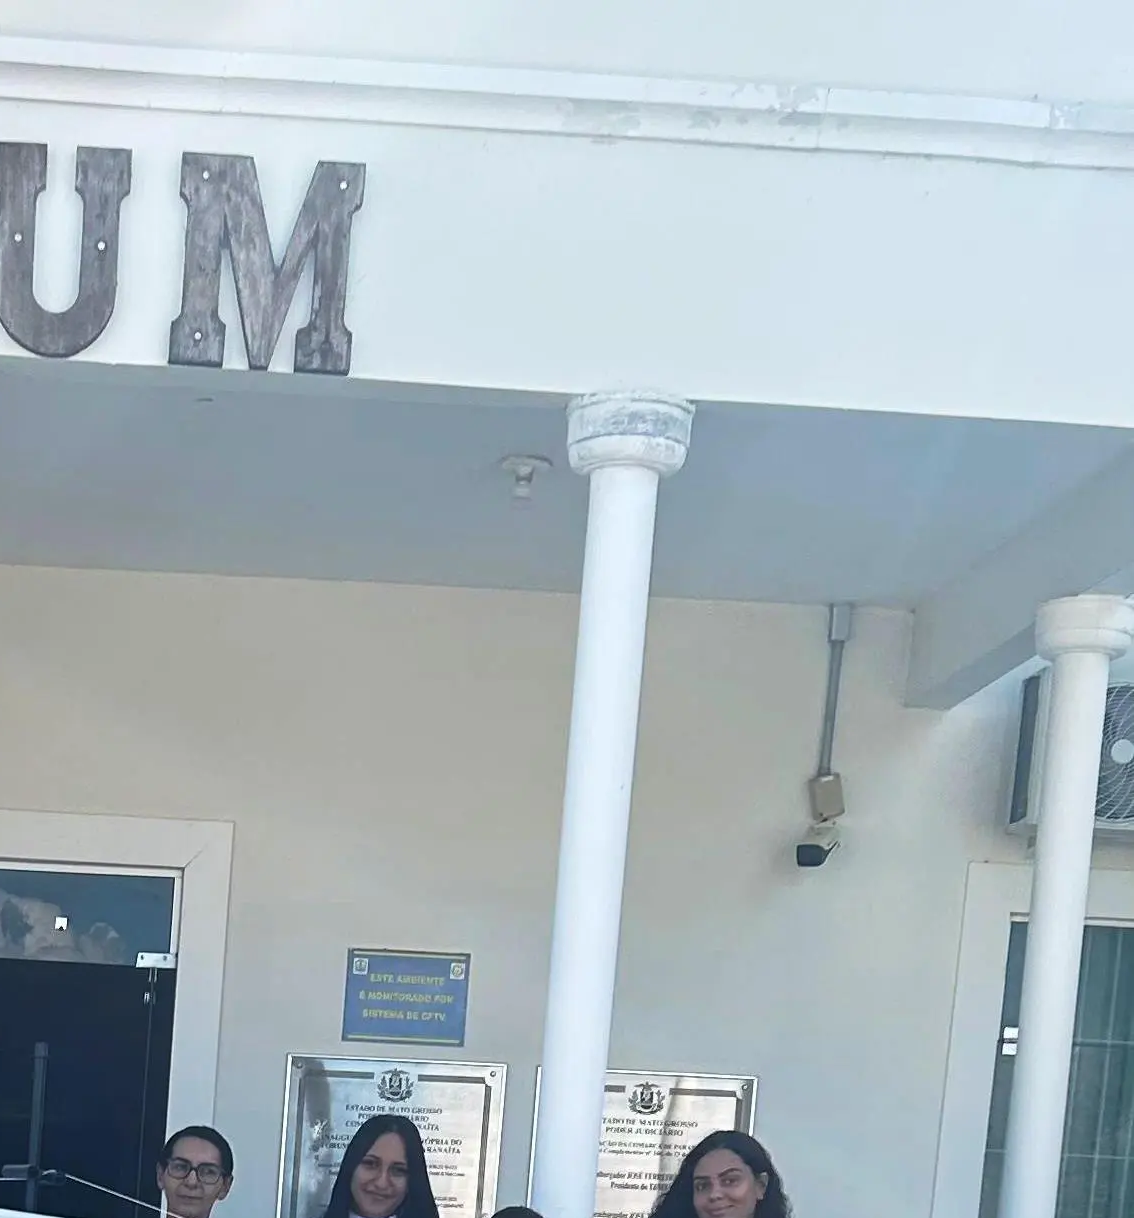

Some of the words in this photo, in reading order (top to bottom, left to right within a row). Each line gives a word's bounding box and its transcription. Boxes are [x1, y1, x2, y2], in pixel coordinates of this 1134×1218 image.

[370, 973, 394, 983] ESTE
[397, 975, 445, 986] AMBIENTE
[368, 991, 432, 1003] MONITORADO
[434, 995, 454, 1004] POR
[362, 1009, 404, 1019] SISTEMA
[406, 1011, 419, 1020] DE
[346, 1104, 375, 1112] ESTADO
